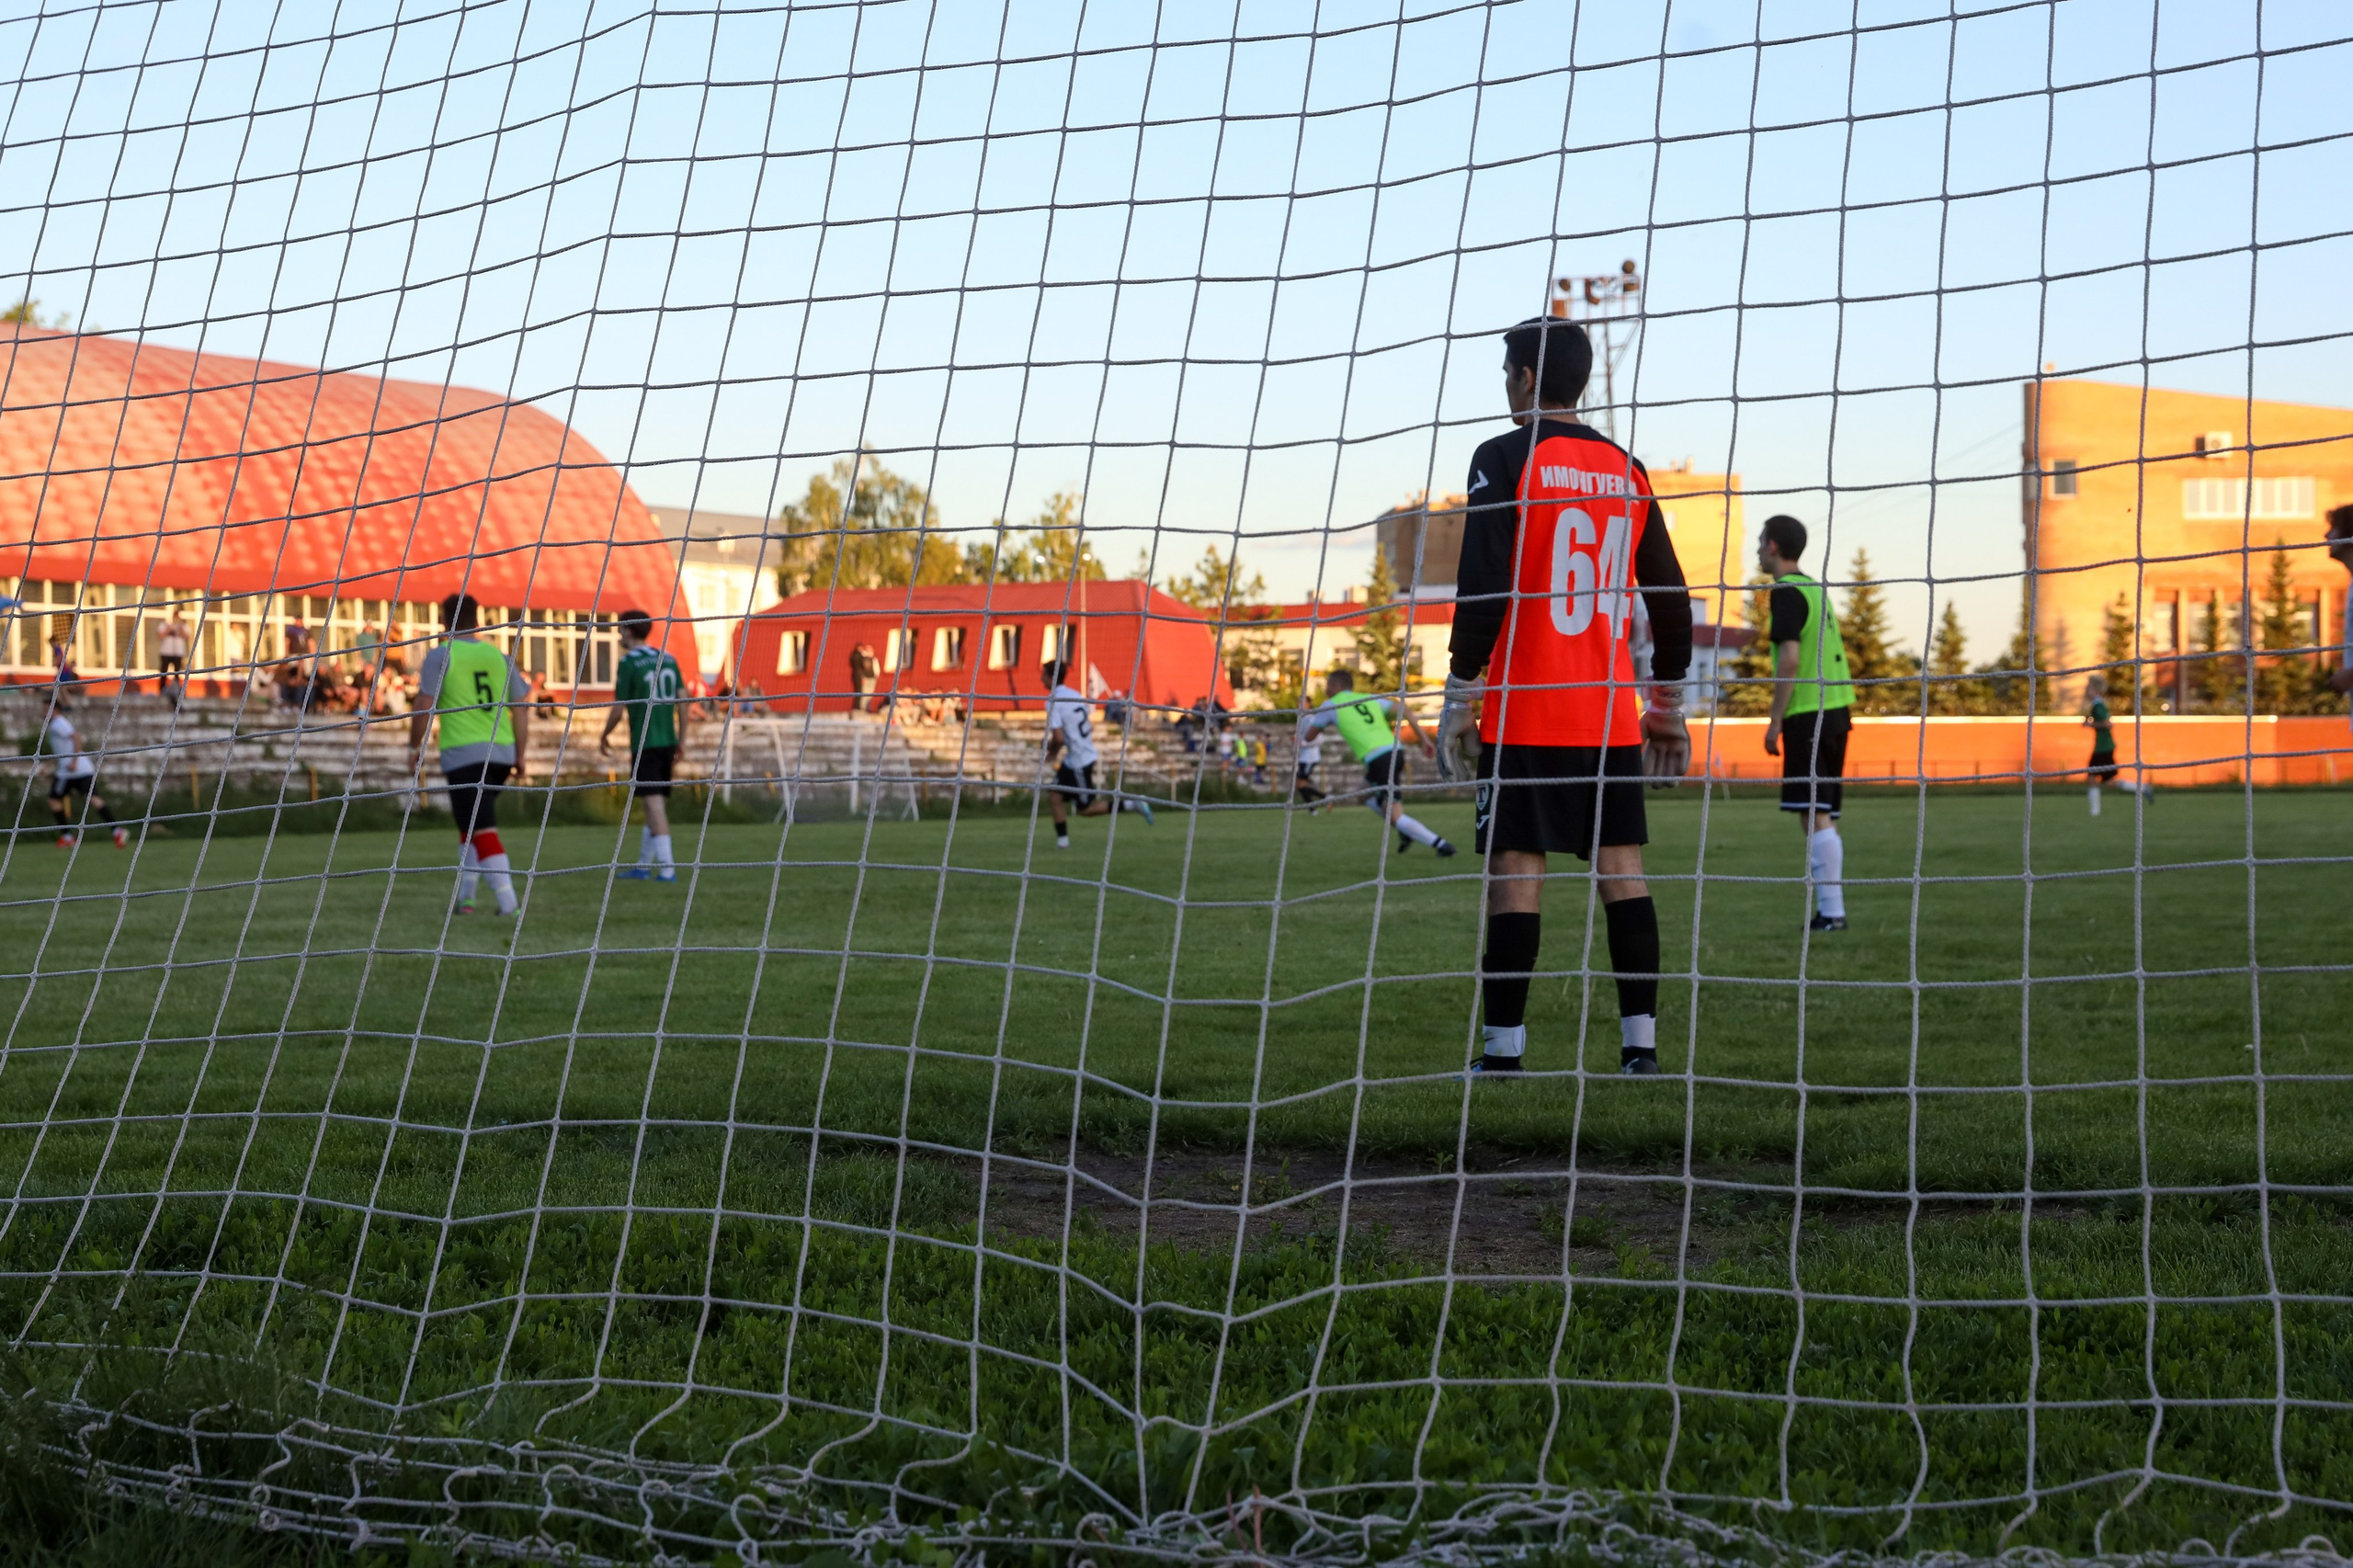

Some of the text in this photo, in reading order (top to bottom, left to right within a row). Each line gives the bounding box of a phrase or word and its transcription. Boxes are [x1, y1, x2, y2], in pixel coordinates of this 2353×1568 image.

[1550, 507, 1632, 639] 64
[473, 671, 493, 712] 5
[643, 667, 677, 701] 10
[1074, 706, 1092, 738] 2
[1354, 703, 1374, 724] 9
